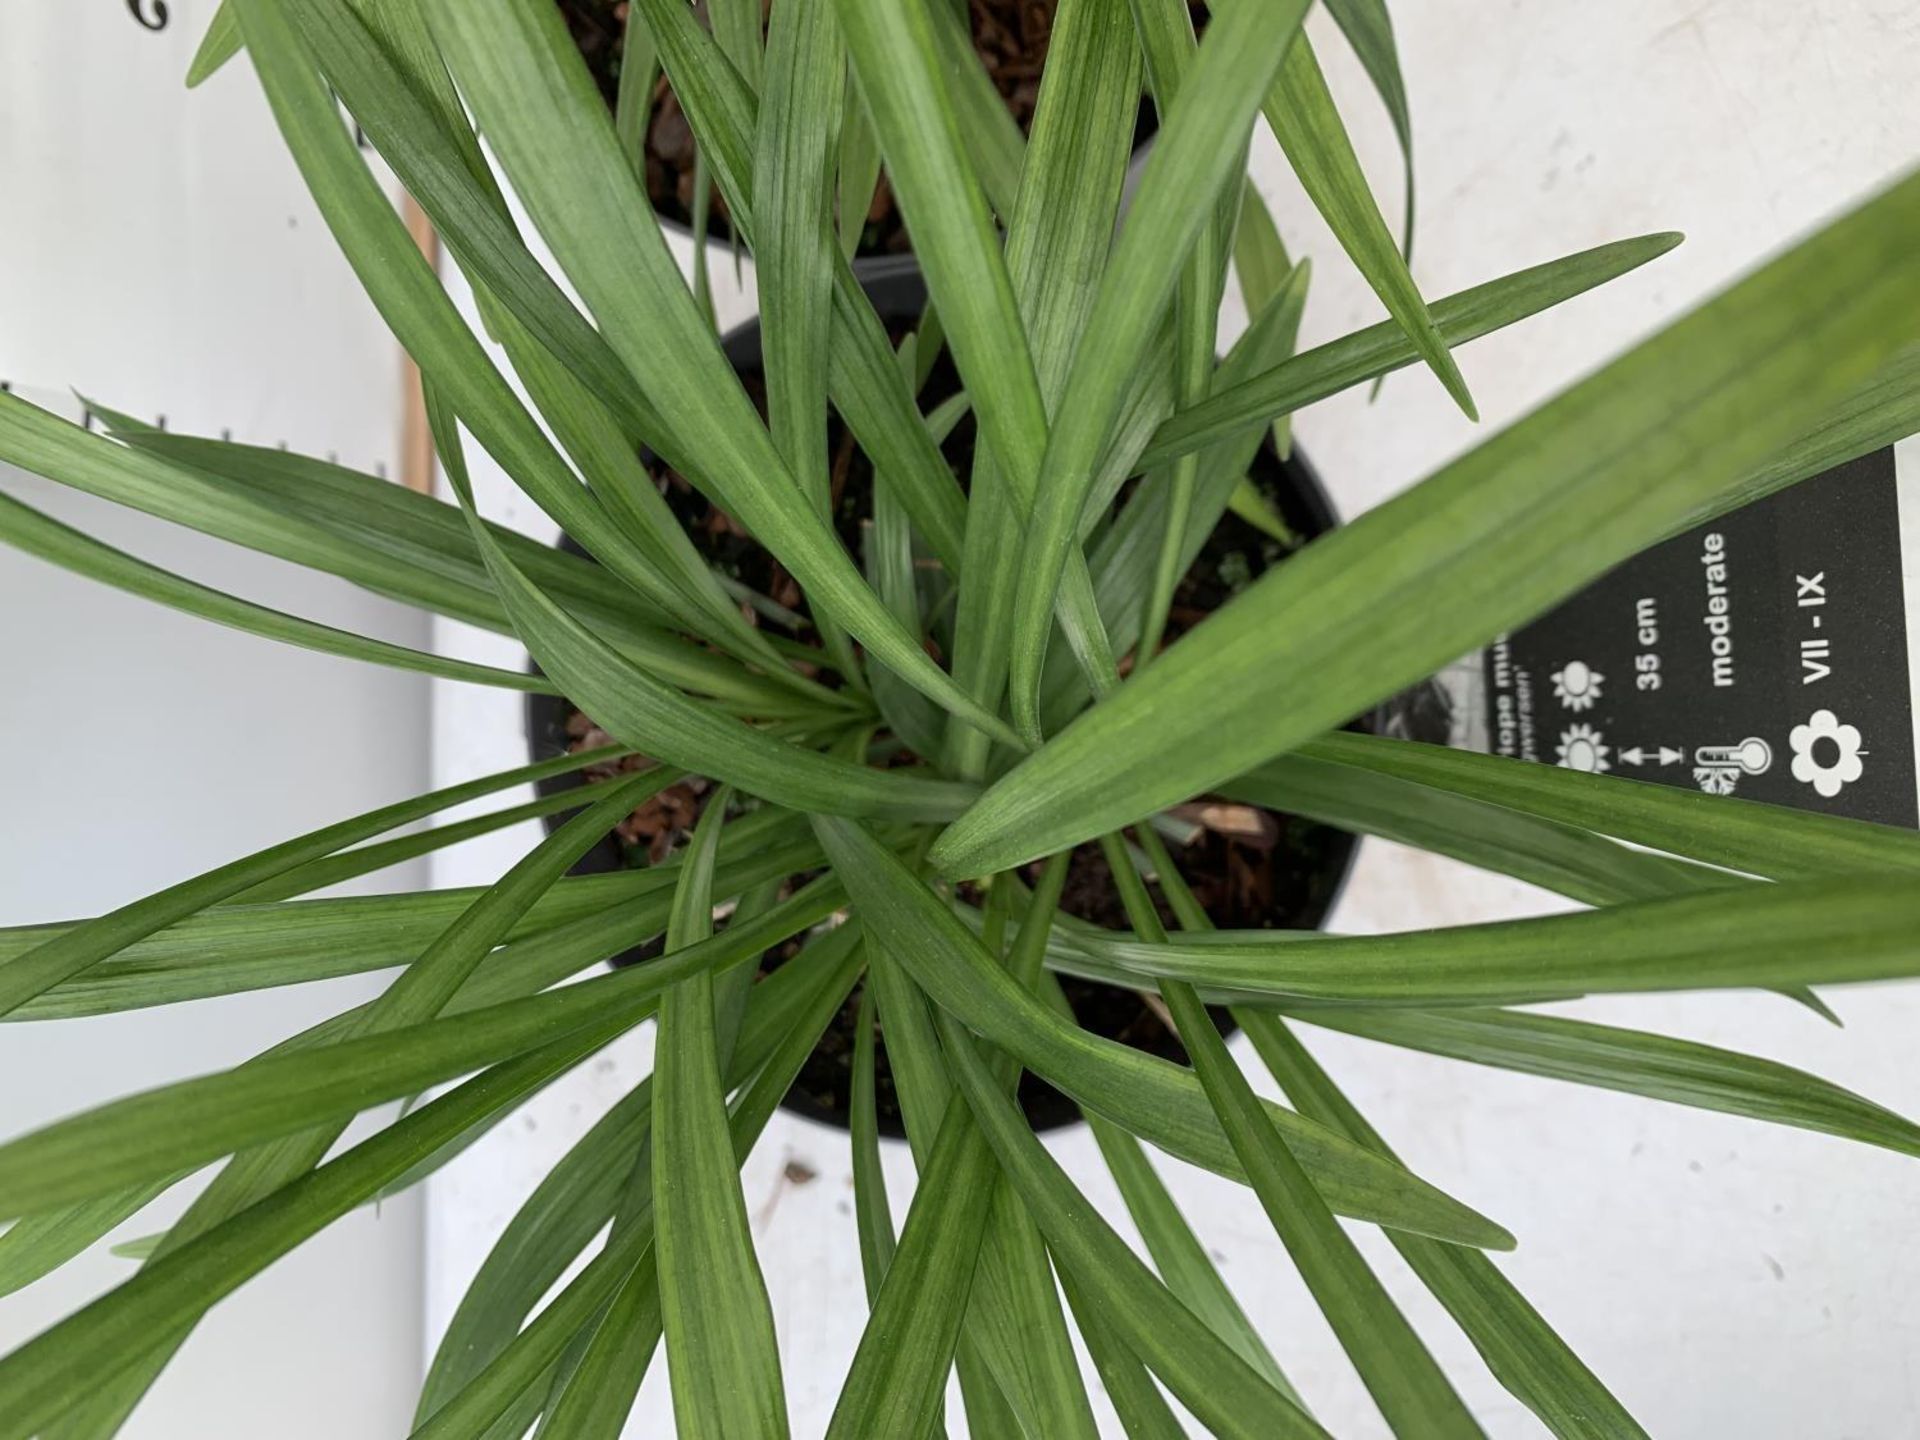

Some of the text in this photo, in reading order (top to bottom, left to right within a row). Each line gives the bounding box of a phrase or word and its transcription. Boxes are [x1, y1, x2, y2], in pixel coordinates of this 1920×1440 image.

[1635, 598, 1662, 690] 35 cm
[1701, 533, 1734, 687] moderate
[1796, 571, 1831, 685] VII - IX
